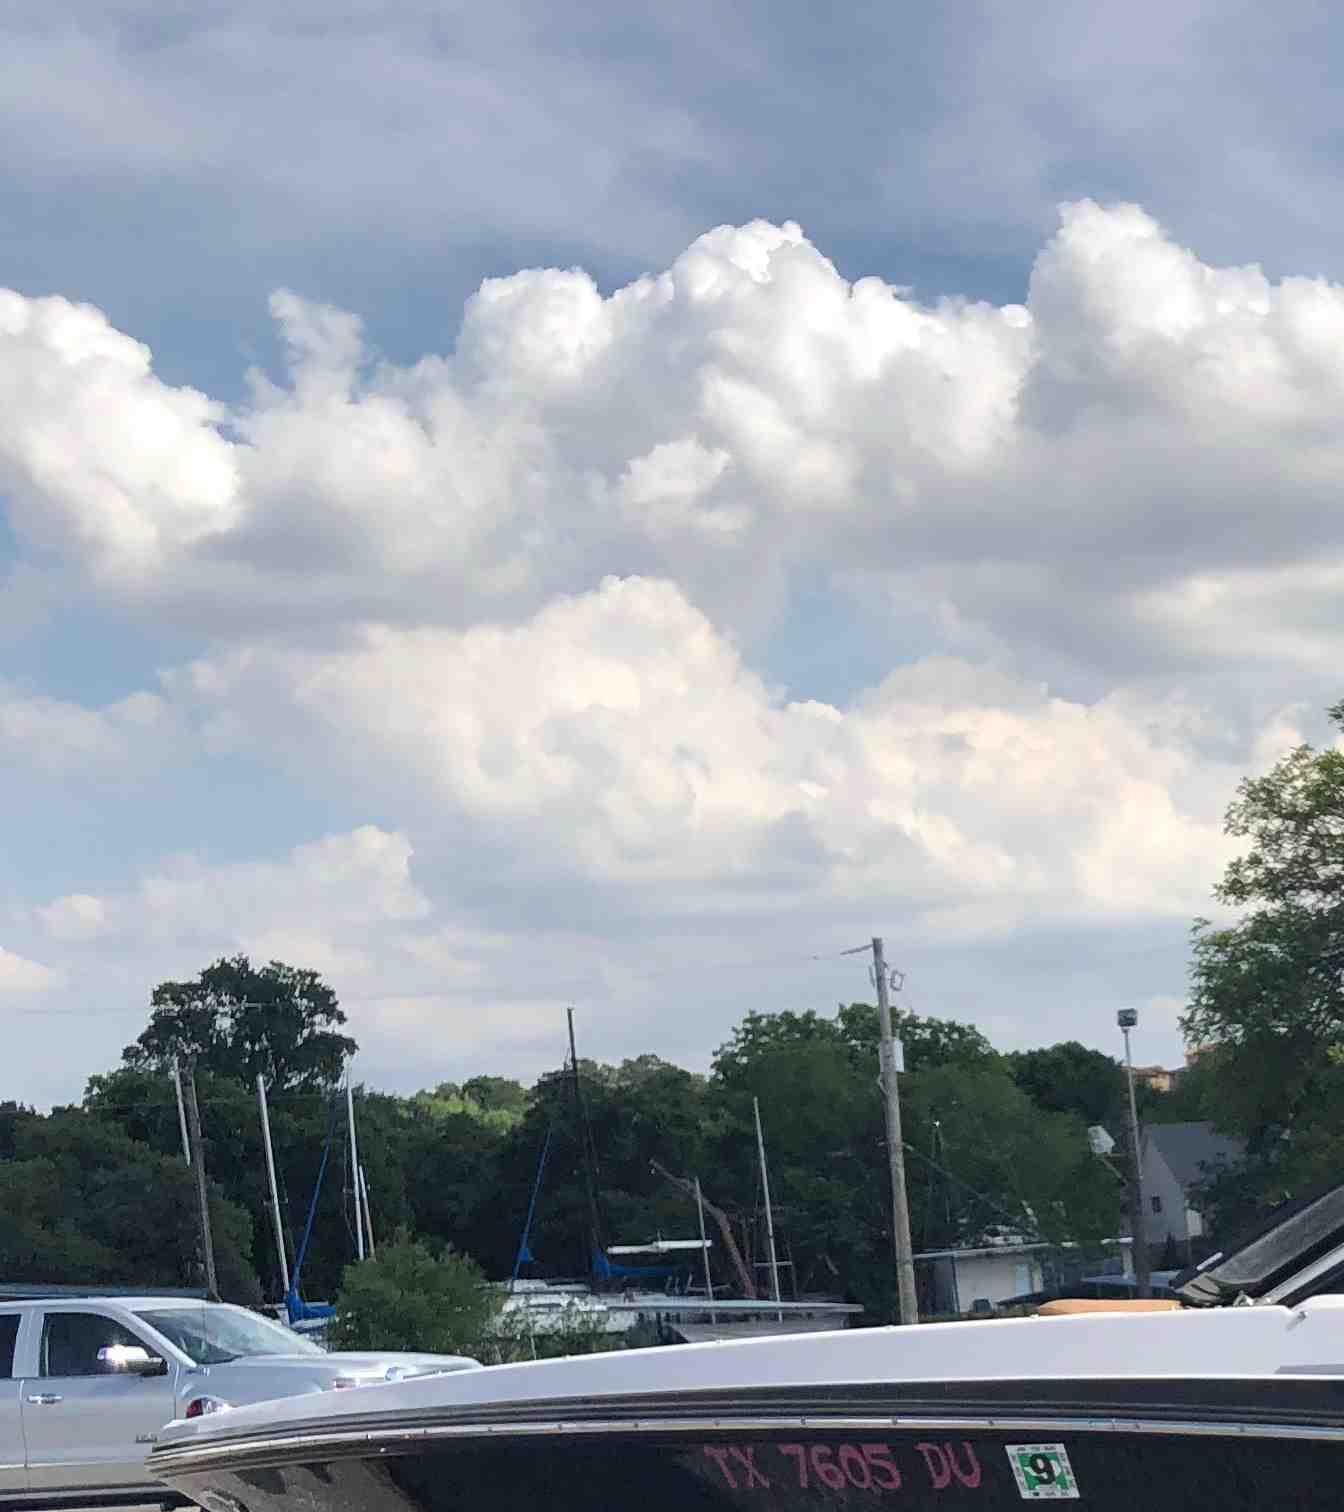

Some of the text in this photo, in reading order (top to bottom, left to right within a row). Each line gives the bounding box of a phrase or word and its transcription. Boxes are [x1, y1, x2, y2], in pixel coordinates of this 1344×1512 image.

[703, 1444, 770, 1488] TX
[777, 1443, 900, 1489] 7605
[915, 1441, 981, 1488] DU
[1029, 1453, 1057, 1485] 9
